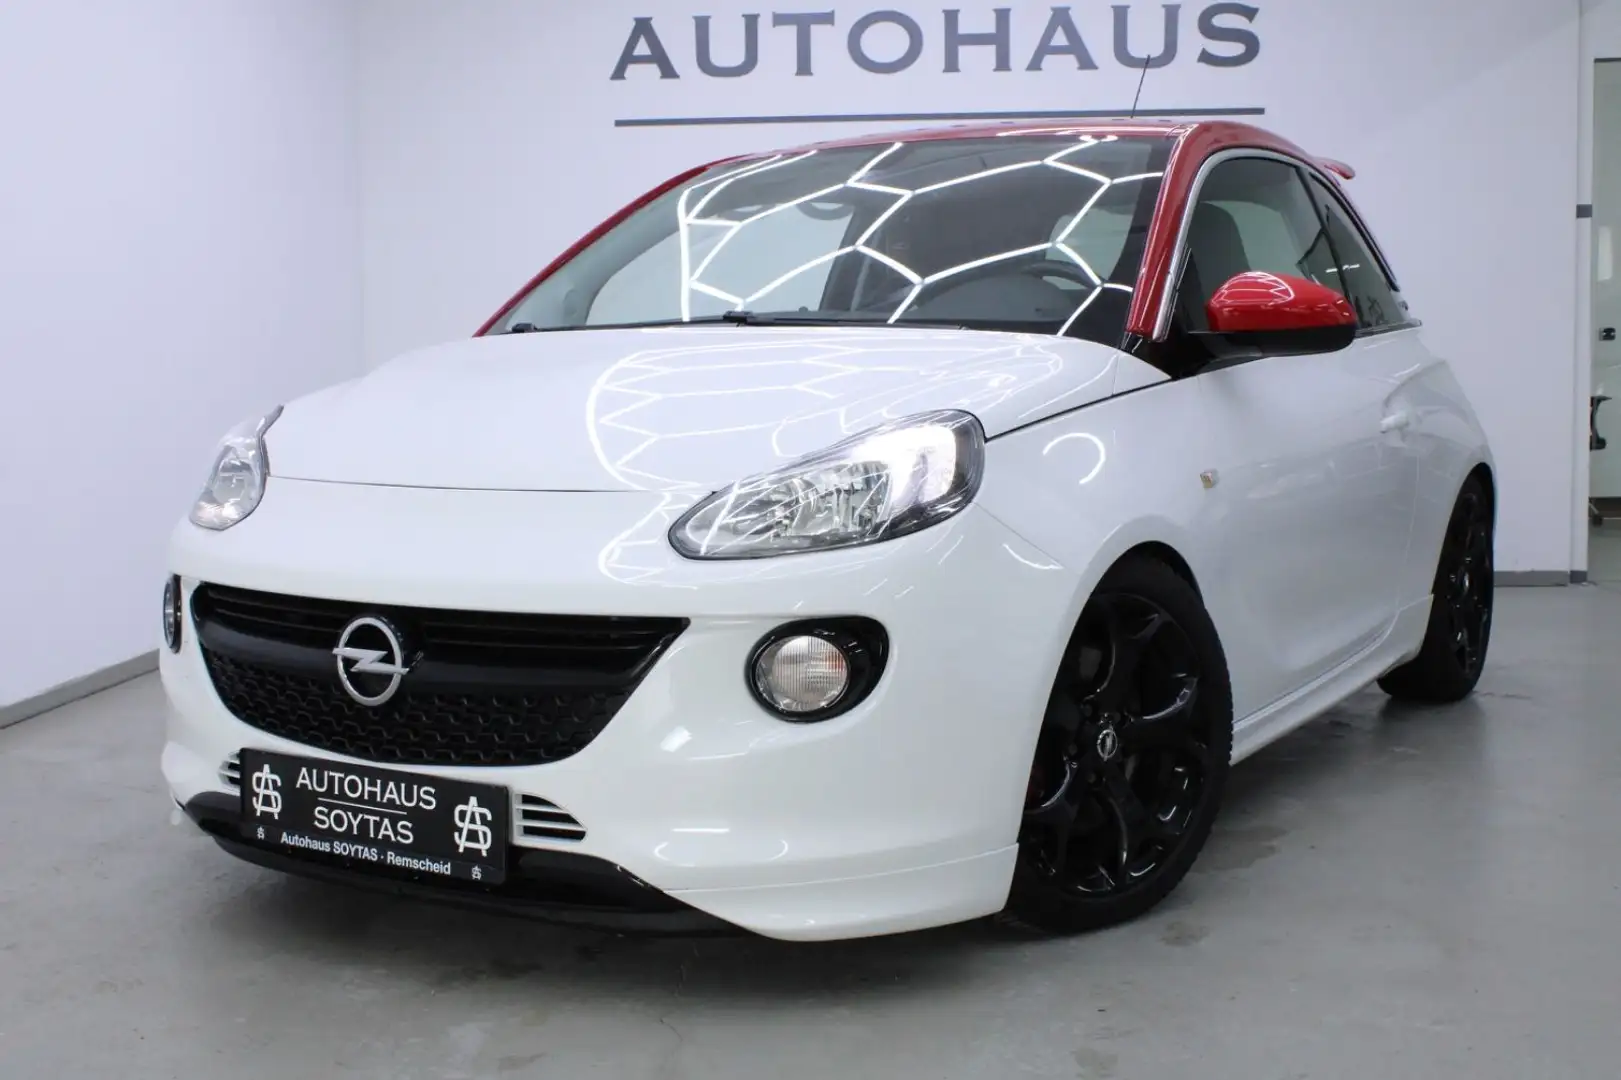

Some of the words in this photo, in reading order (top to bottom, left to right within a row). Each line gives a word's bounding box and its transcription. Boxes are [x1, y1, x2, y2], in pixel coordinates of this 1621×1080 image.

[610, 2, 1261, 81] AUTOHAUS
[295, 766, 437, 811] AUTOHAUS
[313, 805, 414, 845] SOYTAS
[280, 831, 331, 852] Autohaus
[333, 840, 379, 862] SOYTAS
[386, 850, 452, 876] Remscheid
